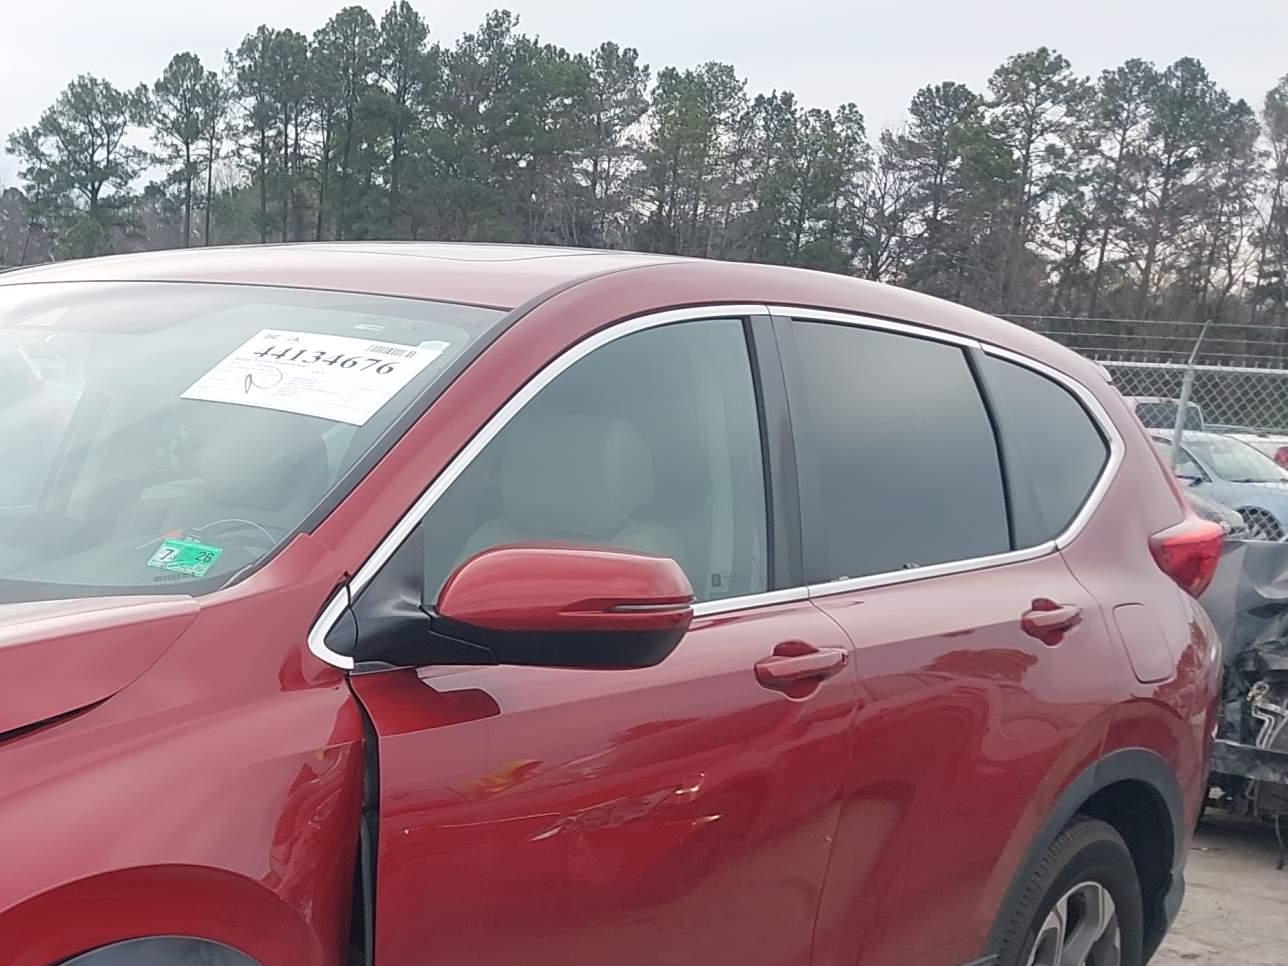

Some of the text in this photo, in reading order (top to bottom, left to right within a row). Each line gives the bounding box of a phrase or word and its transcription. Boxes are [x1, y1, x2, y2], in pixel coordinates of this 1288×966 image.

[253, 345, 400, 375] 44134676
[160, 549, 174, 560] 7
[194, 551, 215, 562] 26
